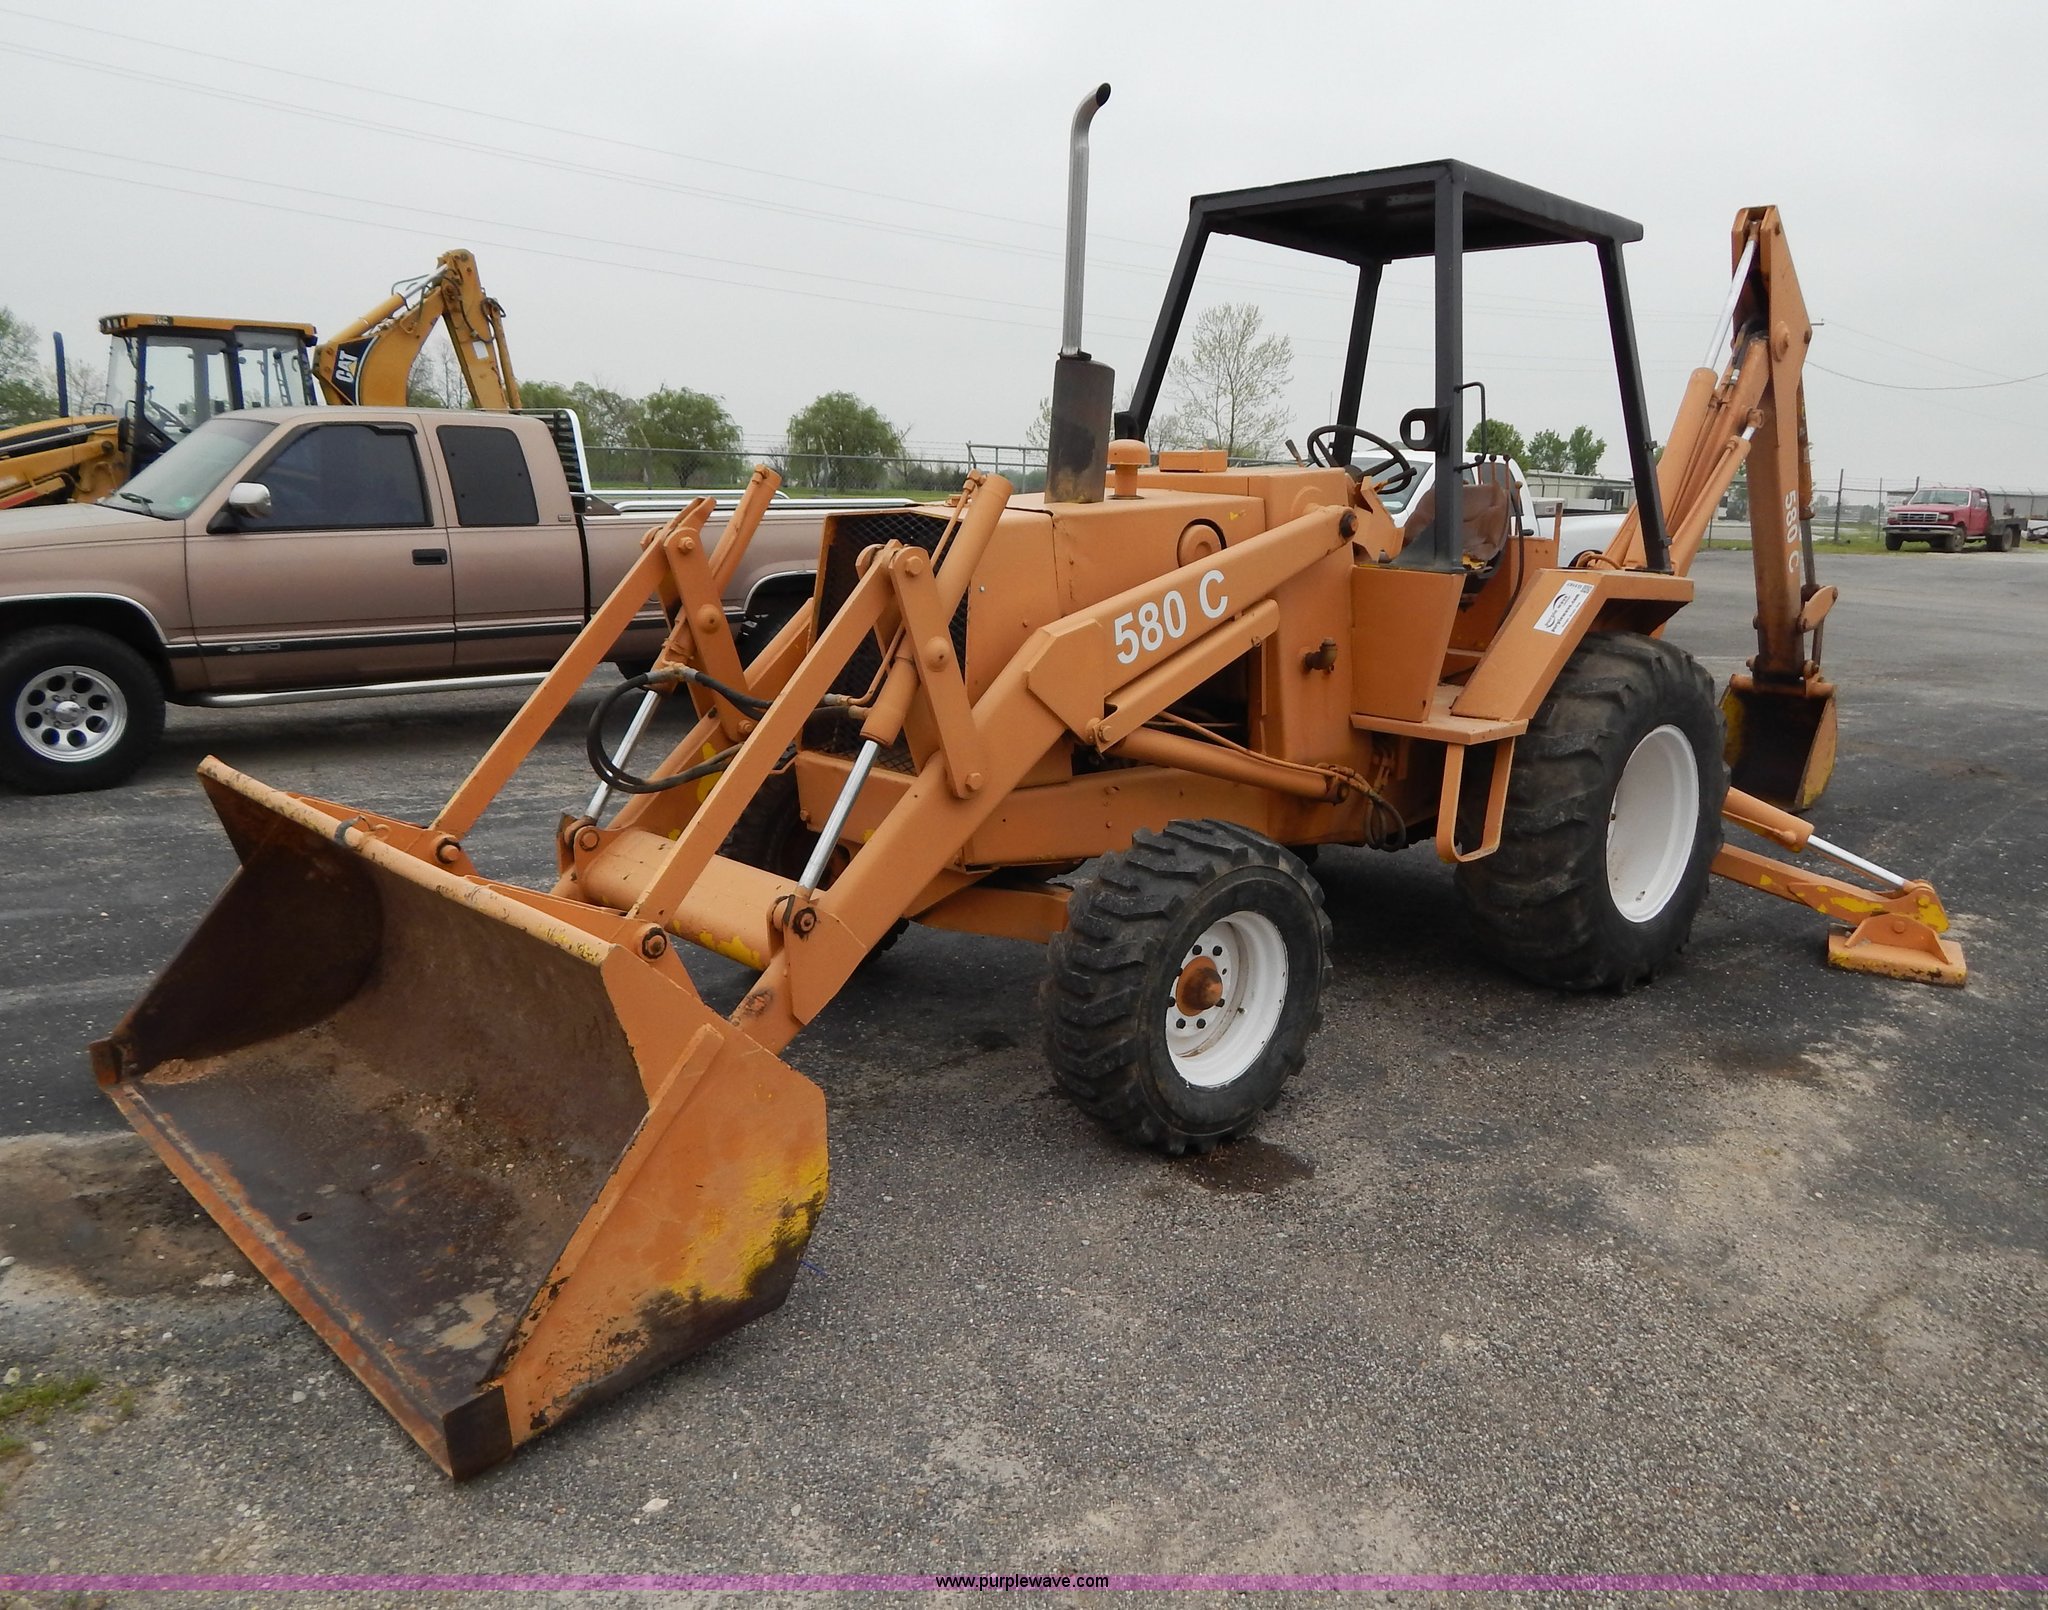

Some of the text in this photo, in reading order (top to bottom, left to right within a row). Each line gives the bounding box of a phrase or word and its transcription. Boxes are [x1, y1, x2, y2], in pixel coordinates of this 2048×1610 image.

[336, 350, 358, 383] CAT
[1785, 490, 1799, 573] 580 C
[1114, 569, 1228, 664] 580 C
